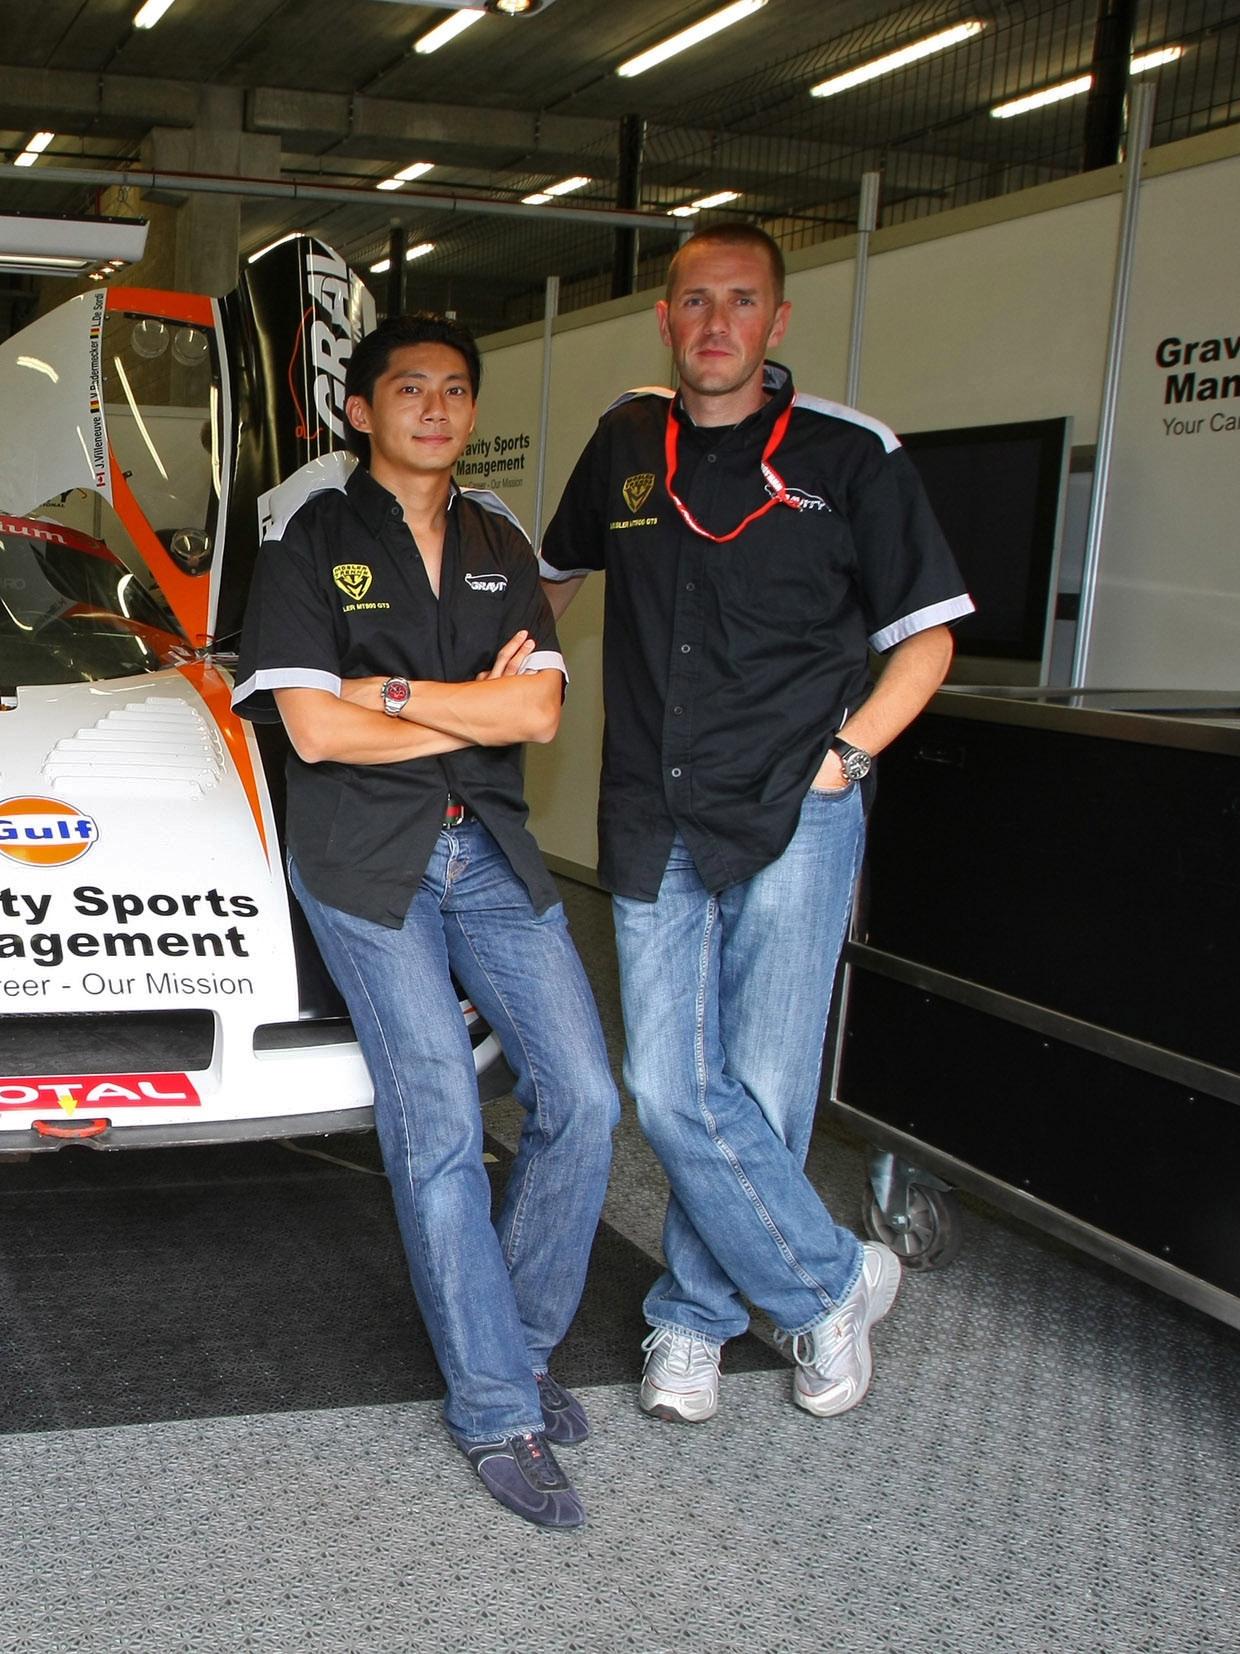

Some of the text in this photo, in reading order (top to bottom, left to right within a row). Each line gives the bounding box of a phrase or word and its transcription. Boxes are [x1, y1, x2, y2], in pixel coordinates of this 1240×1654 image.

[1163, 416, 1205, 436] Your
[94, 416, 105, 469] J.Villeneuve
[462, 434, 530, 457] avity Sports
[456, 453, 525, 477] Management
[74, 886, 259, 924] Sports
[81, 973, 136, 995] Our
[146, 972, 253, 995] Mission
